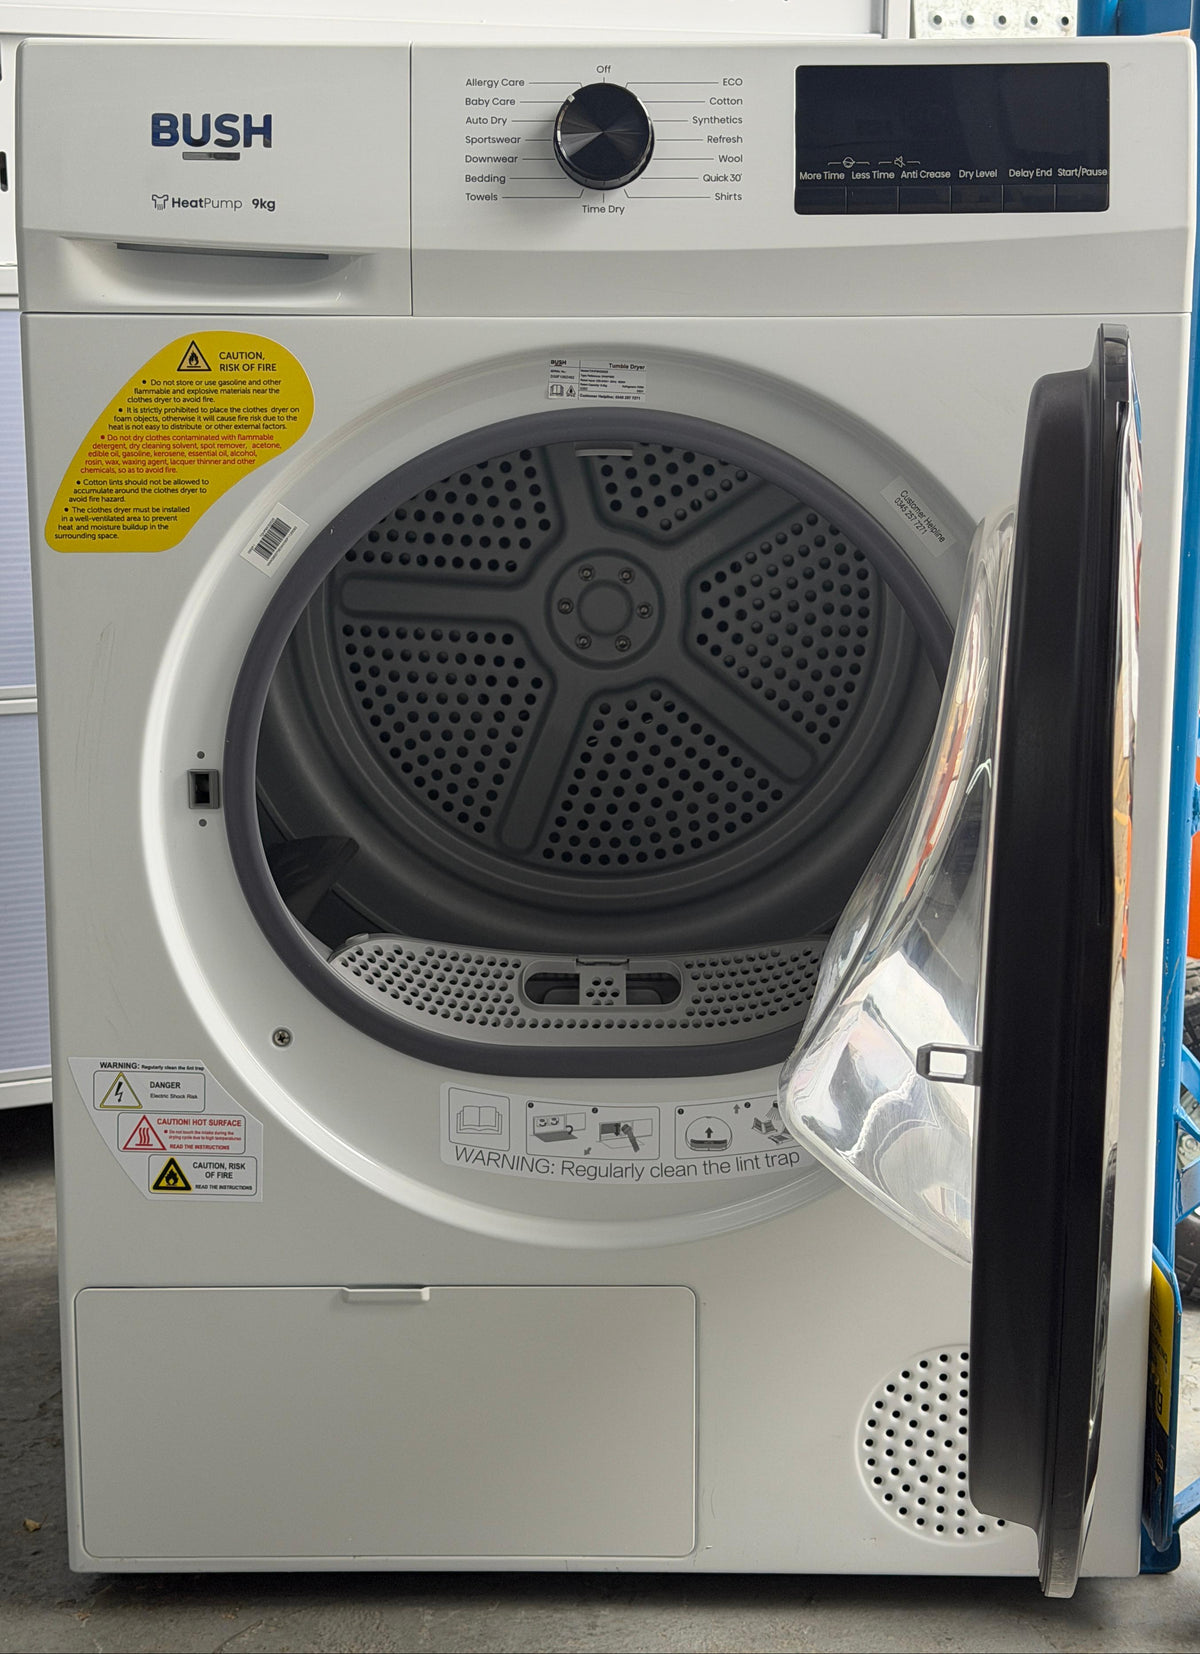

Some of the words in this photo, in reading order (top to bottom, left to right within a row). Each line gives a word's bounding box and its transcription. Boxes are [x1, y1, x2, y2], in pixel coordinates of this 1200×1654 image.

[596, 65, 611, 74] Off
[465, 79, 499, 88] Allergy
[501, 79, 525, 87] Care
[723, 78, 743, 86] ECO
[465, 98, 490, 107] Baby
[492, 98, 516, 106] Care
[709, 97, 743, 105] Cotton
[465, 116, 489, 125] Auto
[491, 116, 507, 126] Dry
[692, 116, 743, 126] Synthetics
[151, 113, 272, 148] BUSH
[465, 136, 521, 145] Sportswear
[707, 135, 743, 144] Refresh
[465, 155, 518, 163] Downwear
[719, 154, 743, 163] Wool
[799, 171, 822, 180] More
[823, 171, 845, 180] Time
[852, 171, 870, 179] Less
[872, 170, 895, 179] Time
[900, 170, 918, 179] Anti
[920, 170, 951, 179] Crease
[958, 169, 975, 180] Dry
[976, 169, 998, 178] Level
[1008, 168, 1034, 179] Delay
[1036, 168, 1053, 177] End
[1057, 166, 1108, 178] Start/Pause
[465, 174, 506, 184] Bedding
[703, 174, 728, 182] Quick
[465, 193, 498, 201] Towels
[714, 192, 742, 201] Shirts
[172, 197, 243, 212] HeatPump
[252, 198, 276, 212] 9kg
[582, 205, 606, 214] Time
[608, 205, 625, 215] Dry
[219, 351, 265, 361] CAUTION,
[219, 363, 240, 372] RISK
[242, 363, 255, 372] OF
[257, 363, 277, 372] FIRE
[150, 378, 161, 386] Do
[163, 378, 175, 386] not
[176, 378, 194, 386] store
[218, 378, 247, 388] gasoline
[248, 378, 261, 386] and
[262, 378, 281, 386] other
[187, 387, 218, 396] explosive
[154, 396, 172, 405] dryer
[140, 406, 162, 415] strictly
[164, 406, 199, 415] prohibited
[209, 406, 228, 415] place
[271, 406, 289, 415] dryer
[114, 414, 132, 422] foam
[133, 414, 160, 424] objects,
[162, 414, 196, 422] otherwise
[197, 414, 202, 422] it
[203, 414, 215, 422] will
[237, 414, 249, 422] fire
[250, 414, 262, 422] risk
[263, 414, 276, 422] due
[277, 414, 285, 422] to
[286, 414, 297, 422] the
[145, 424, 160, 432] easy
[83, 478, 108, 486] Cotton
[109, 478, 123, 486] lints
[124, 478, 148, 486] should
[149, 478, 162, 486] not
[163, 478, 172, 486] be
[173, 478, 200, 486] allowed
[201, 478, 209, 486] to
[180, 487, 198, 496] dryer
[113, 506, 131, 515] dryer
[61, 514, 68, 522] in
[74, 514, 125, 522] well-ventilated
[143, 514, 150, 522] to
[152, 514, 177, 524] prevent
[894, 497, 908, 513] 0345
[905, 510, 917, 522] 257
[914, 520, 928, 535] 7271
[900, 490, 926, 519] Customer
[924, 517, 946, 543] Helpline
[122, 523, 148, 532] buildup
[55, 532, 96, 541] surrounding
[98, 533, 119, 541] space.
[100, 1062, 140, 1070] WARNING:
[208, 1119, 242, 1127] SURFACE
[193, 1162, 227, 1170] CAUTION,
[228, 1162, 246, 1170] RISK
[455, 1145, 554, 1174] WARNING:
[561, 1160, 644, 1182] Regularly
[650, 1162, 697, 1178] clean
[703, 1159, 732, 1175] the
[736, 1155, 760, 1171] lint
[765, 1149, 800, 1167] trap
